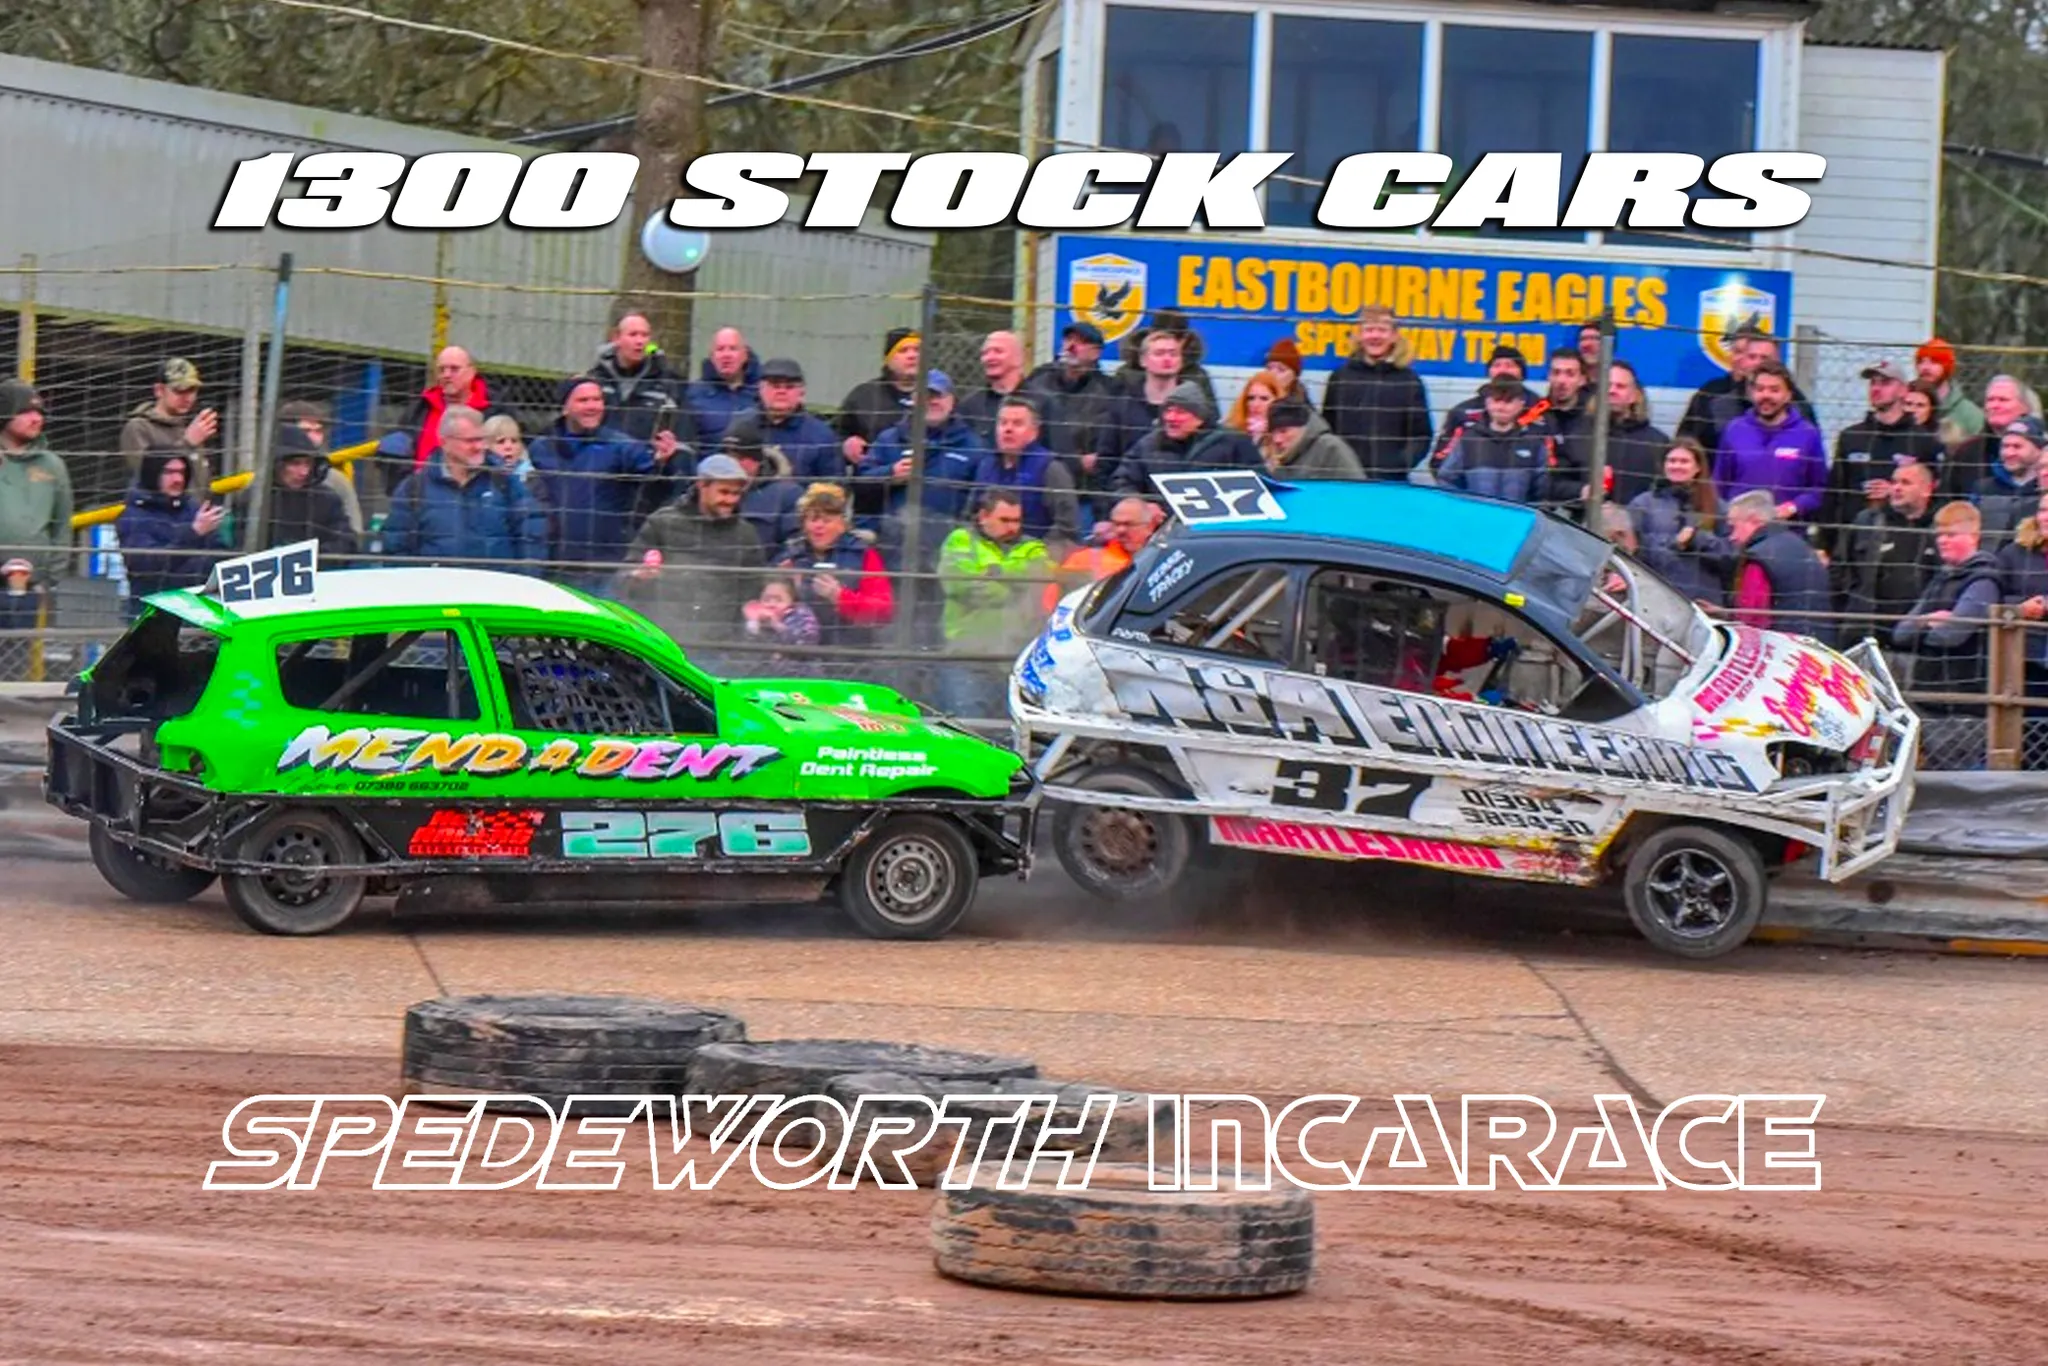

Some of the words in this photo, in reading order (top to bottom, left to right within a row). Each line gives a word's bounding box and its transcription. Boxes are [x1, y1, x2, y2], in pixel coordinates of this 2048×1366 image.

[1178, 255, 1485, 322] EASTBOURNE
[1496, 271, 1668, 330] EAGLES
[1295, 320, 1457, 362] SPEWAY
[1161, 474, 1266, 519] 37
[221, 548, 314, 603] 276
[277, 725, 527, 775] MEND
[529, 738, 579, 773] A
[577, 740, 782, 781] DENT
[816, 745, 928, 762] Paintless
[1347, 684, 1754, 792] ENGINEERING
[800, 761, 854, 777] Dent
[859, 762, 939, 780] Repair
[1270, 757, 1433, 820] 37
[1461, 788, 1564, 815] 01394
[560, 811, 812, 858] 276
